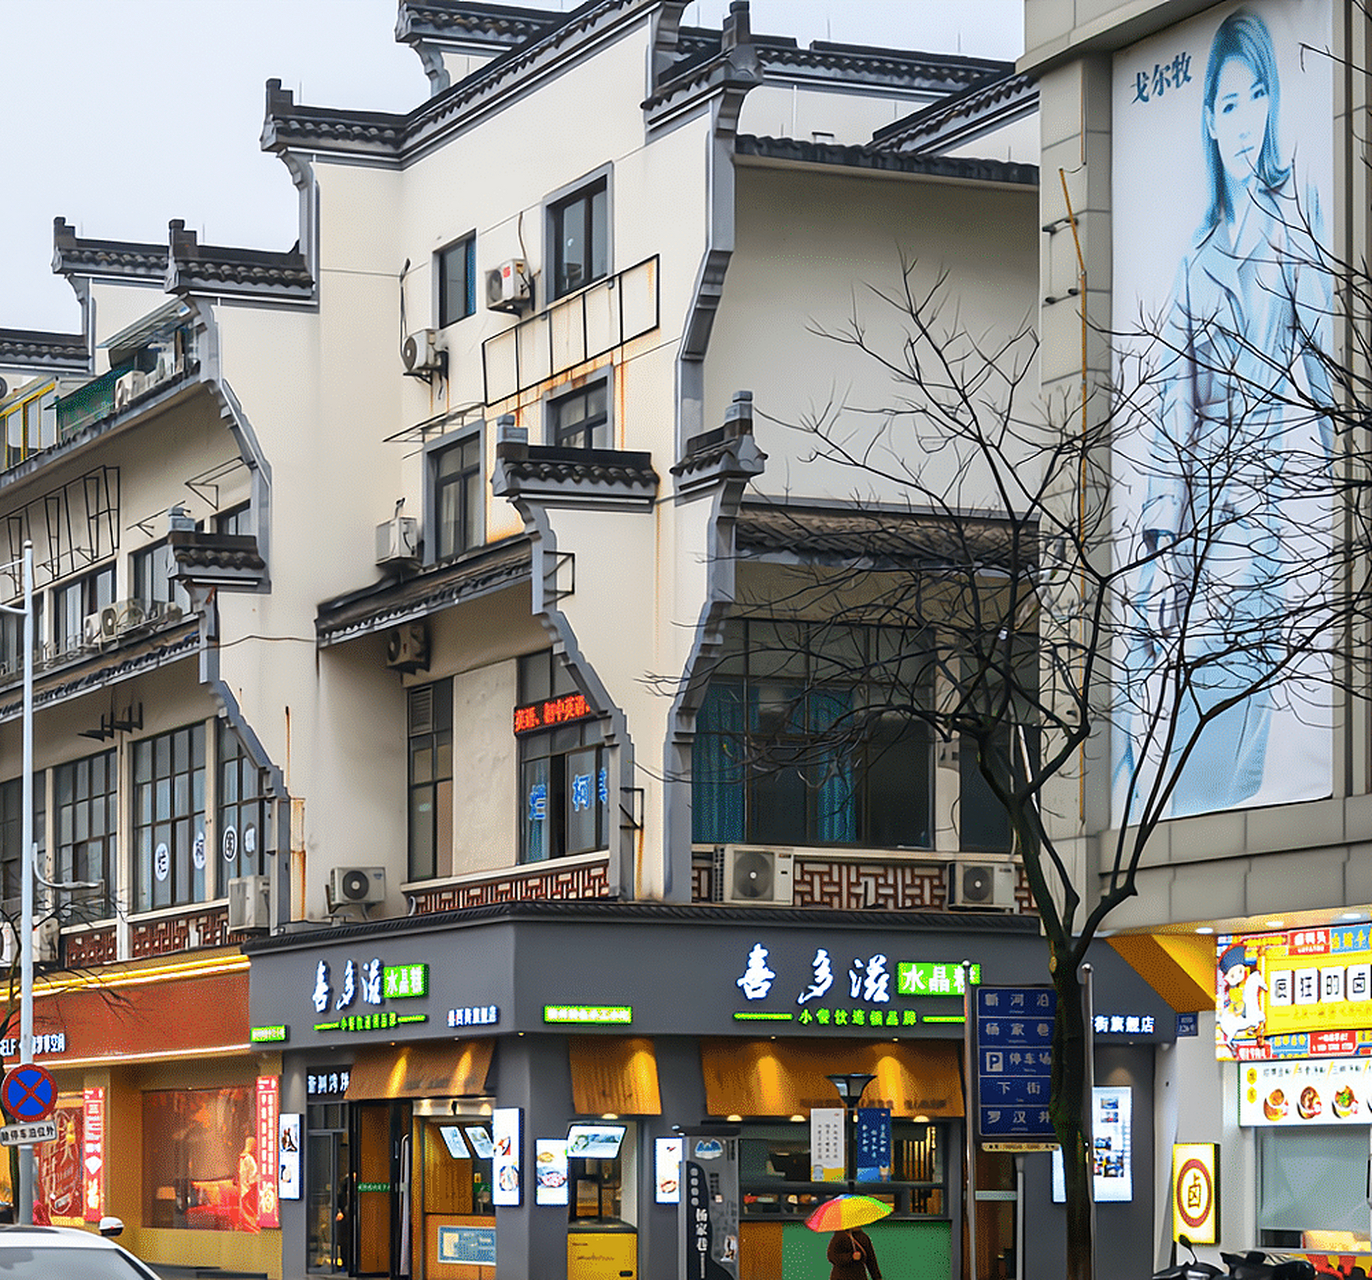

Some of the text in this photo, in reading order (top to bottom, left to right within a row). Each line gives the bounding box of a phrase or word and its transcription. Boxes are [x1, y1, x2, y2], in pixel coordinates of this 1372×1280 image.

[1130, 52, 1192, 104] 戈尔牧
[312, 958, 382, 1013] 喜多滋
[737, 943, 890, 1004] 喜多滋
[1092, 1016, 1154, 1033] 街旗舰店
[1009, 1051, 1052, 1066] 停车场
[998, 1082, 1040, 1096] 下街
[987, 1111, 1050, 1125] 罗汉井
[1188, 1172, 1202, 1209] 卤
